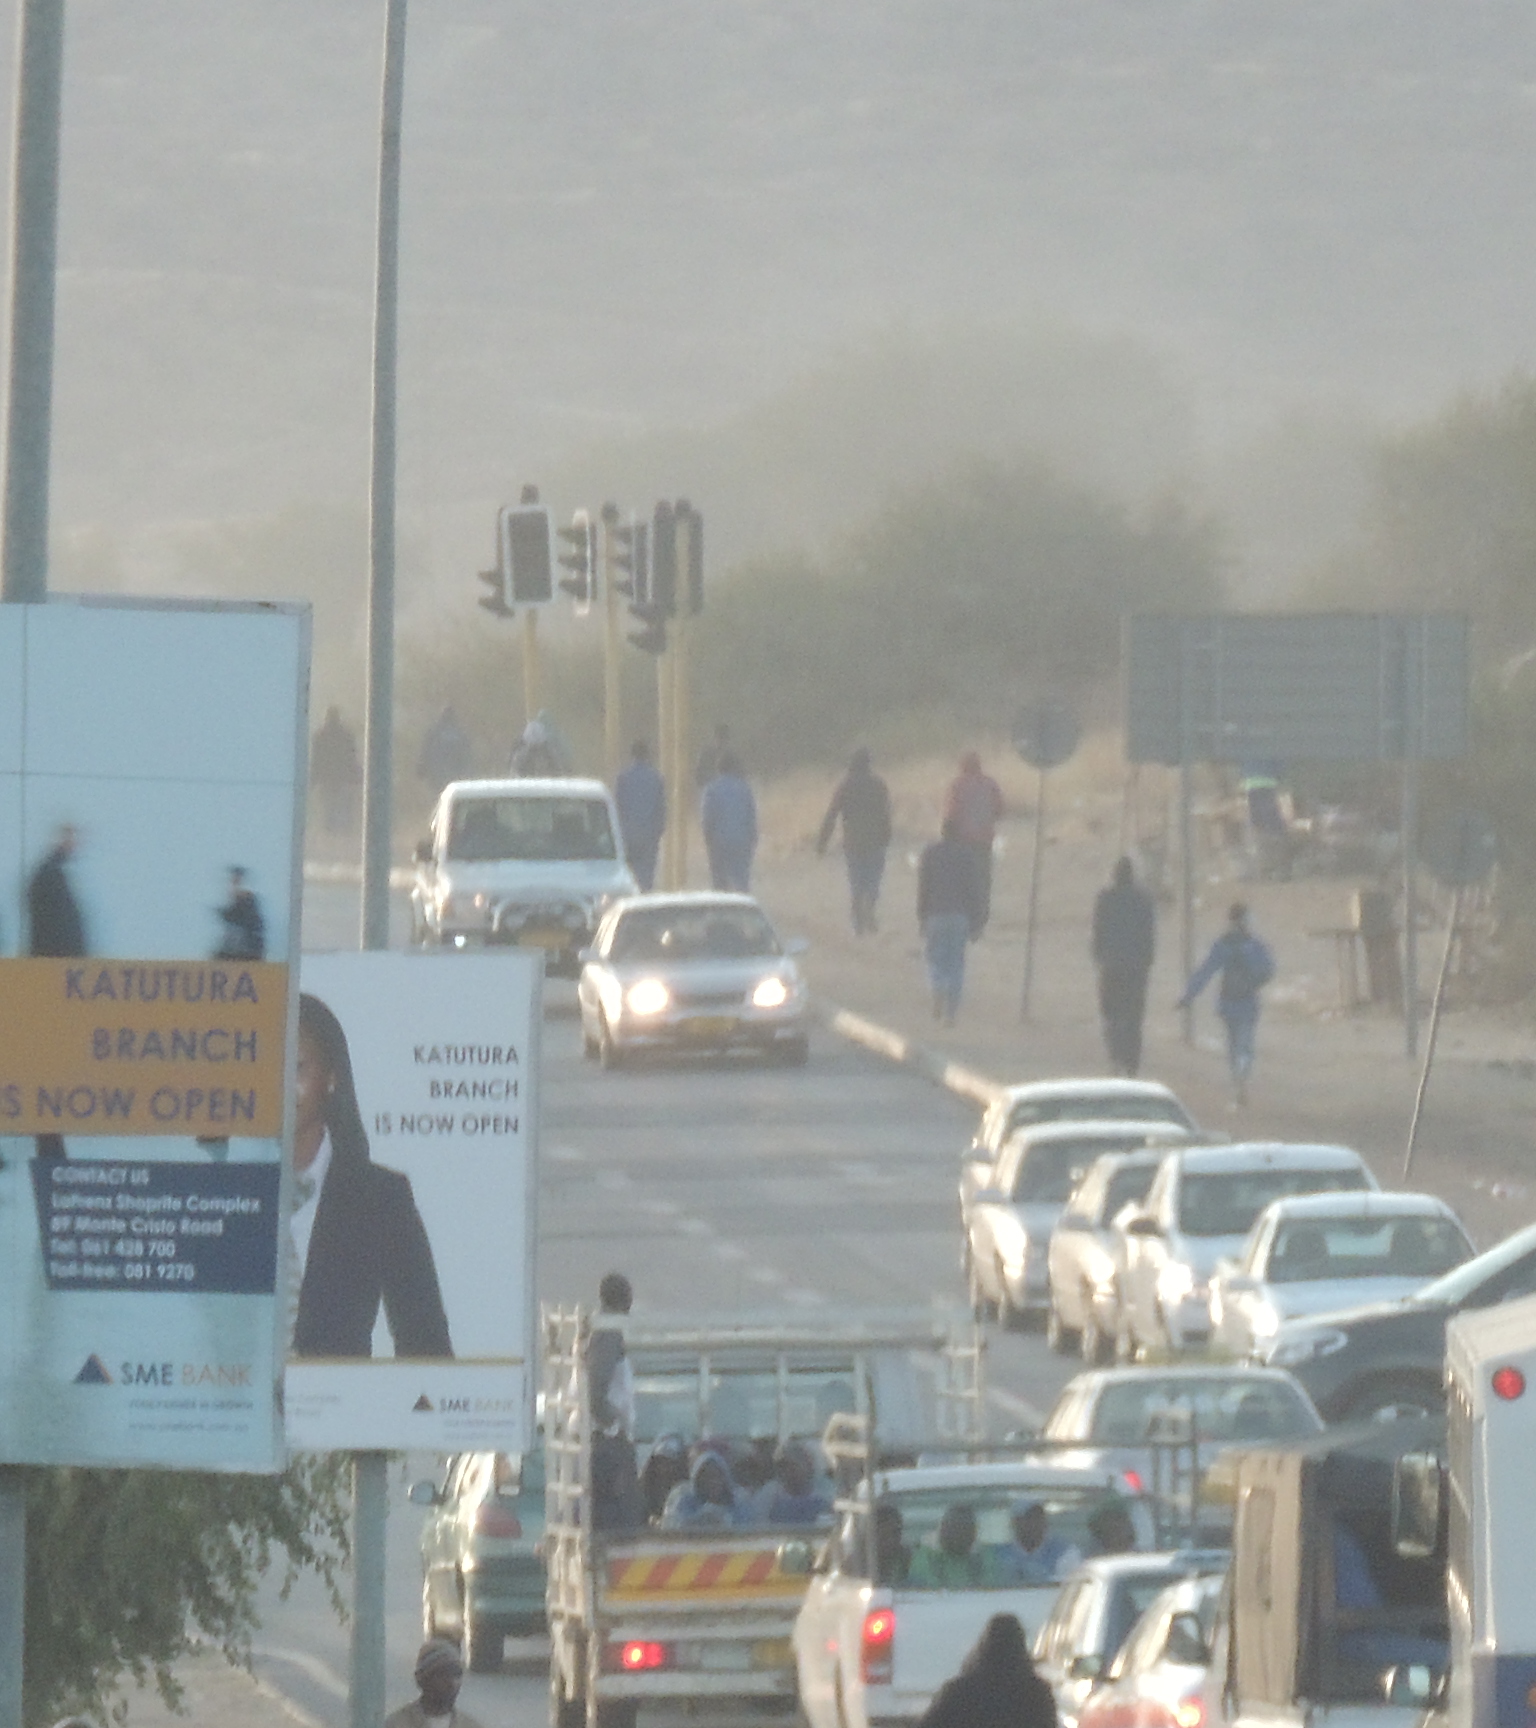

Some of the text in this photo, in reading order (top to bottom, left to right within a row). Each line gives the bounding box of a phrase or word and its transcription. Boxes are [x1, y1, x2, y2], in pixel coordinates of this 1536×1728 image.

[66, 968, 258, 1003] KATUTURA
[92, 1027, 258, 1062] BRANCH
[414, 1044, 519, 1065] KATUTURA
[430, 1079, 518, 1100] BRANCH
[36, 1086, 135, 1119] NOW
[150, 1087, 256, 1121] OPEN
[375, 1112, 519, 1136] IS NOW OPEN
[52, 1166, 150, 1185] CONTACT US
[116, 1193, 182, 1214] Shoprite
[186, 1194, 260, 1214] Complex
[74, 1215, 127, 1234] Monte
[129, 1216, 176, 1235] Cristo
[180, 1217, 224, 1237] Road
[148, 1239, 176, 1258] 700
[123, 1262, 152, 1280] 081
[156, 1263, 196, 1282] 9270
[120, 1361, 254, 1388] SME BANK
[439, 1396, 470, 1414] SME
